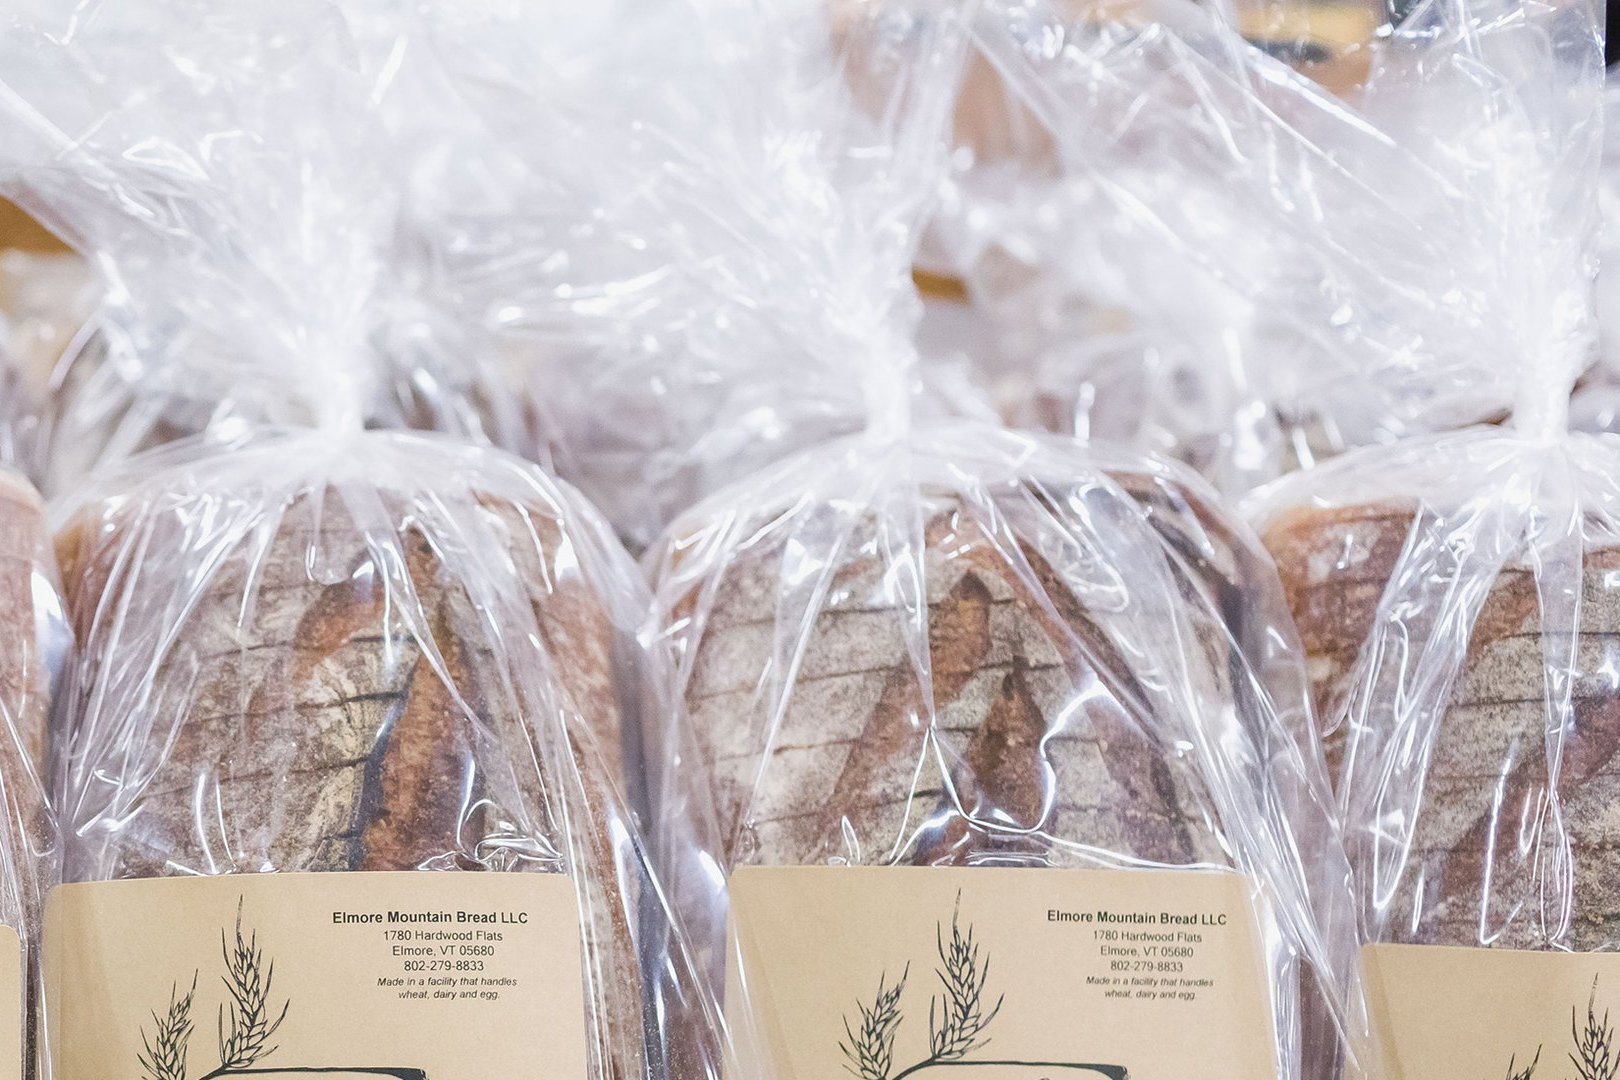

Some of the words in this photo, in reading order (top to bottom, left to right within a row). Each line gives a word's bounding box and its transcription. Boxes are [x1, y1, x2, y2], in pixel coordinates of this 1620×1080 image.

[333, 912, 383, 923] Elmore
[388, 911, 452, 922] Mountain
[457, 911, 496, 923] Bread
[501, 912, 528, 924] LLC
[1048, 910, 1093, 922] Elmore
[1097, 911, 1155, 924] Mountain
[1160, 913, 1197, 925] Bread
[1202, 914, 1226, 925] LLC
[384, 930, 411, 940] 1780
[415, 930, 472, 940] Hardwood
[476, 931, 503, 941] Flats
[1094, 930, 1118, 940] 1780
[1122, 931, 1174, 942] Hardwood
[1178, 932, 1202, 943] Flats
[393, 946, 436, 956] Elmore,
[440, 945, 456, 955] VT
[459, 945, 494, 956] 05680
[1101, 945, 1139, 957] Elmore,
[1144, 947, 1158, 956] VT
[1161, 947, 1193, 957] 05680
[404, 960, 484, 971] 802-279-8833
[1111, 960, 1183, 972] 802-279-8833
